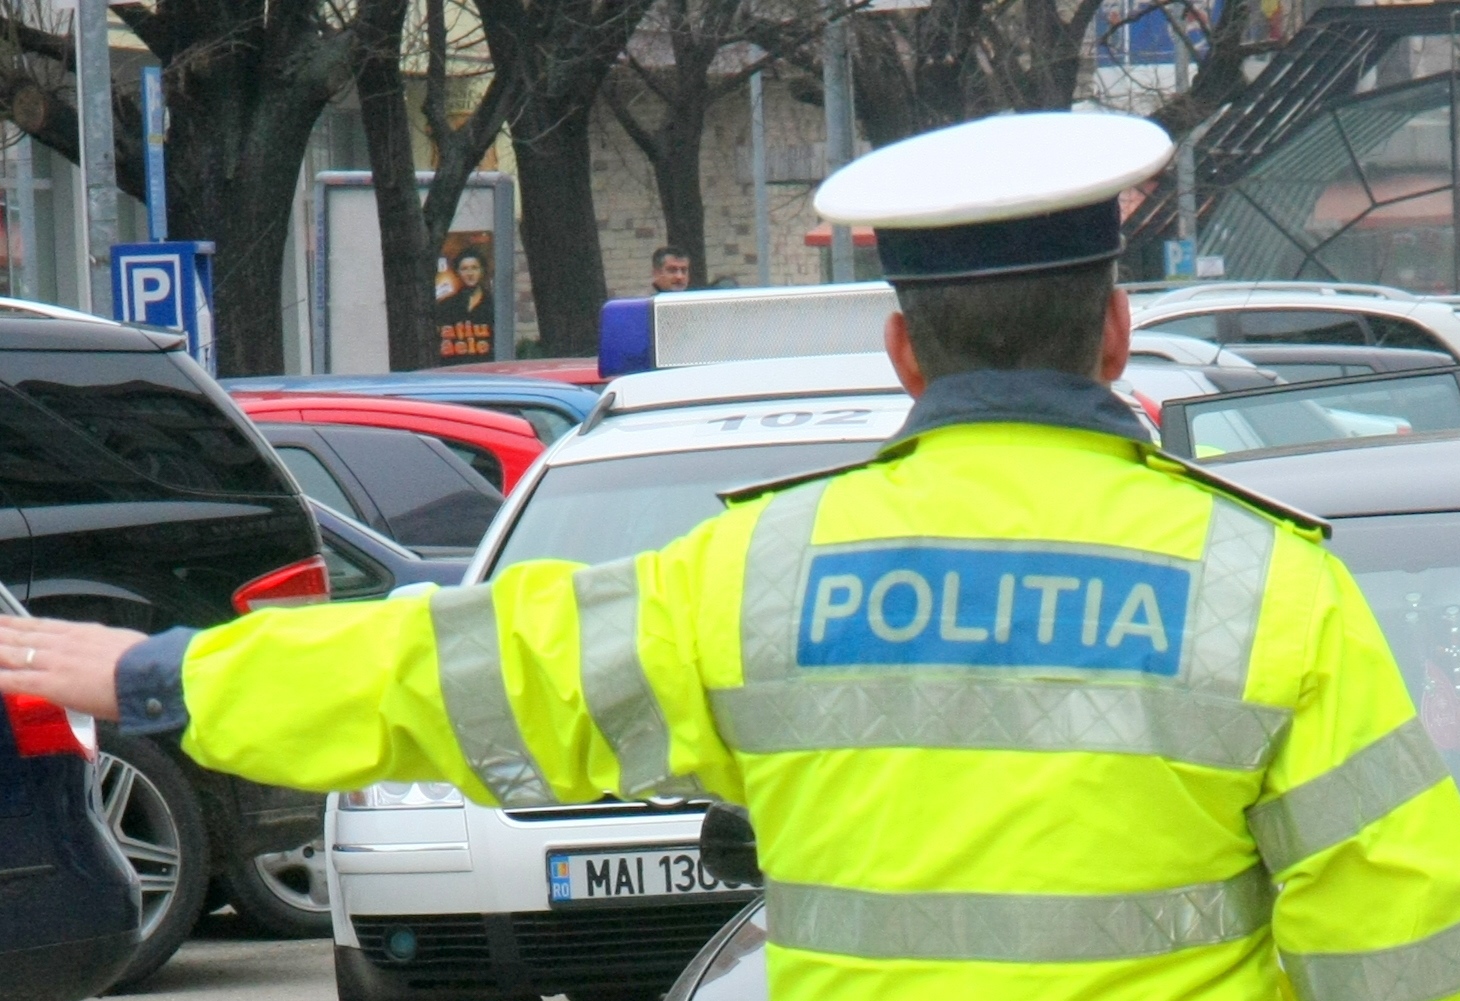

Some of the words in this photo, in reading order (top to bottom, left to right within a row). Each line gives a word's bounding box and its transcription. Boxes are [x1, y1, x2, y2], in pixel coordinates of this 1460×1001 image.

[132, 267, 170, 322] P
[707, 408, 871, 432] 102
[810, 569, 1169, 653] POLITIA
[553, 882, 570, 898] RO
[586, 856, 645, 896] MAI
[659, 854, 764, 893] 130
